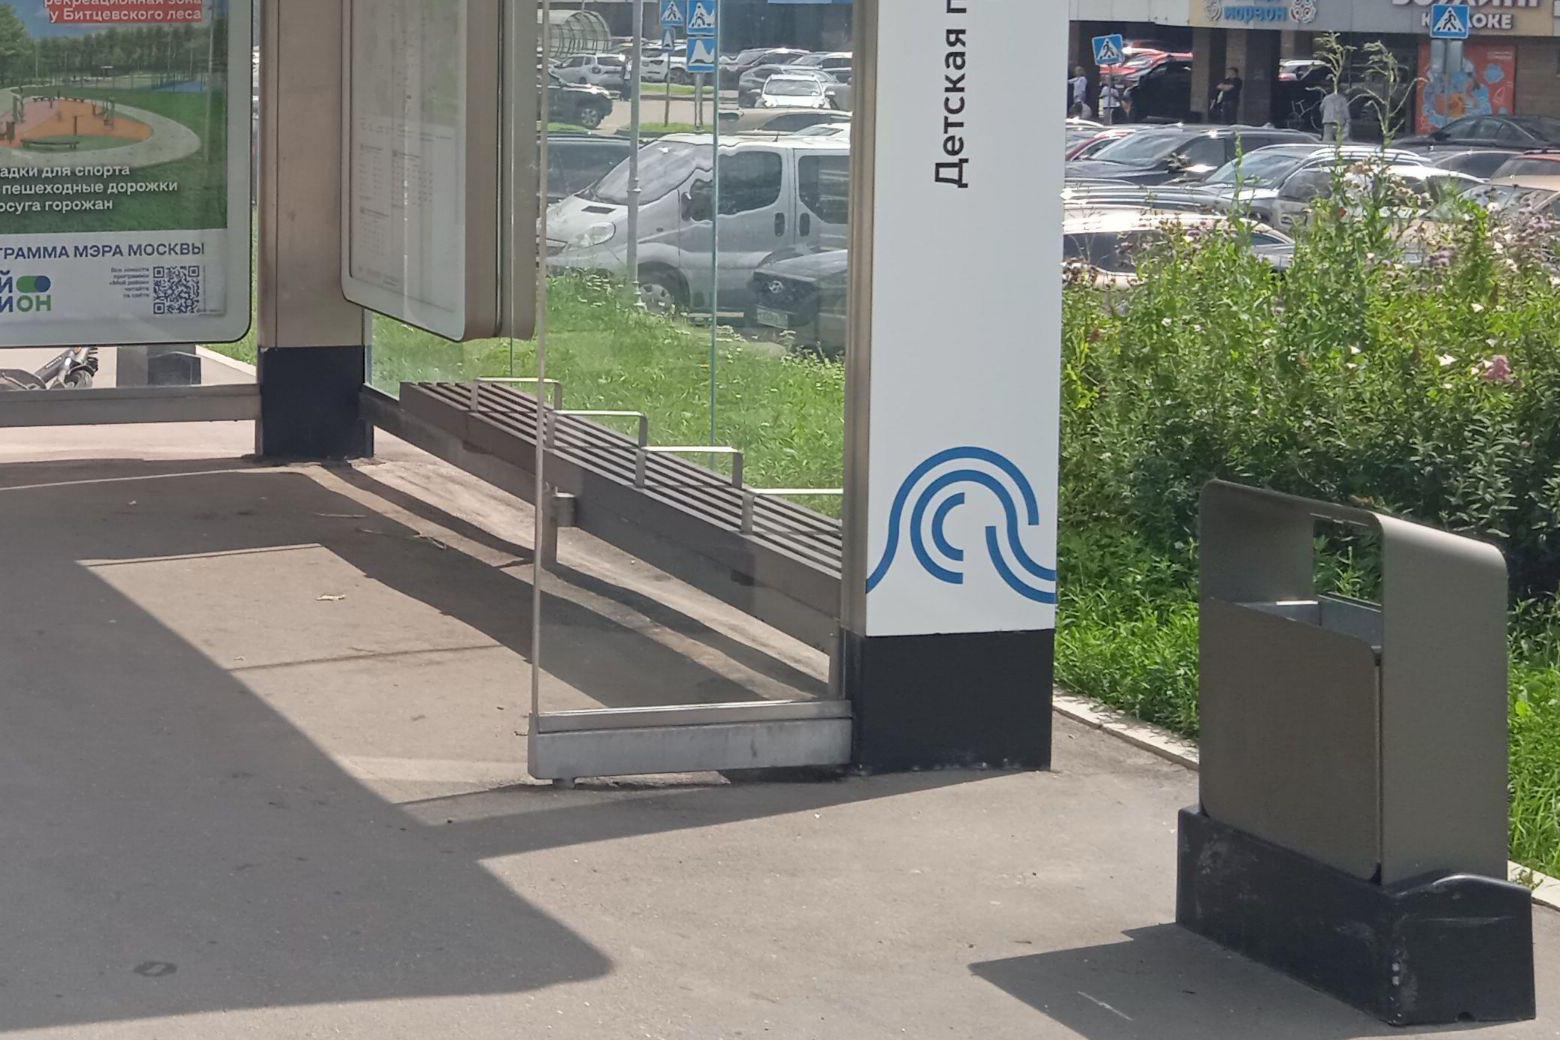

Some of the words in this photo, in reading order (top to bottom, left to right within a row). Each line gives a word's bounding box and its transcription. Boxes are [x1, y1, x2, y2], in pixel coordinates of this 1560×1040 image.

[49, 10, 59, 23] у
[63, 7, 164, 21] Битцевского
[166, 9, 201, 20] леса
[1421, 13, 1513, 29] КОКЕ
[934, 27, 969, 188] Детская
[42, 166, 71, 179] для
[75, 164, 130, 179] спорта
[2, 183, 104, 196] пешеходные
[107, 180, 178, 195] дорожки
[45, 199, 113, 214] горожан
[74, 245, 123, 259] МЭРА
[128, 243, 205, 257] МОСКВЫ
